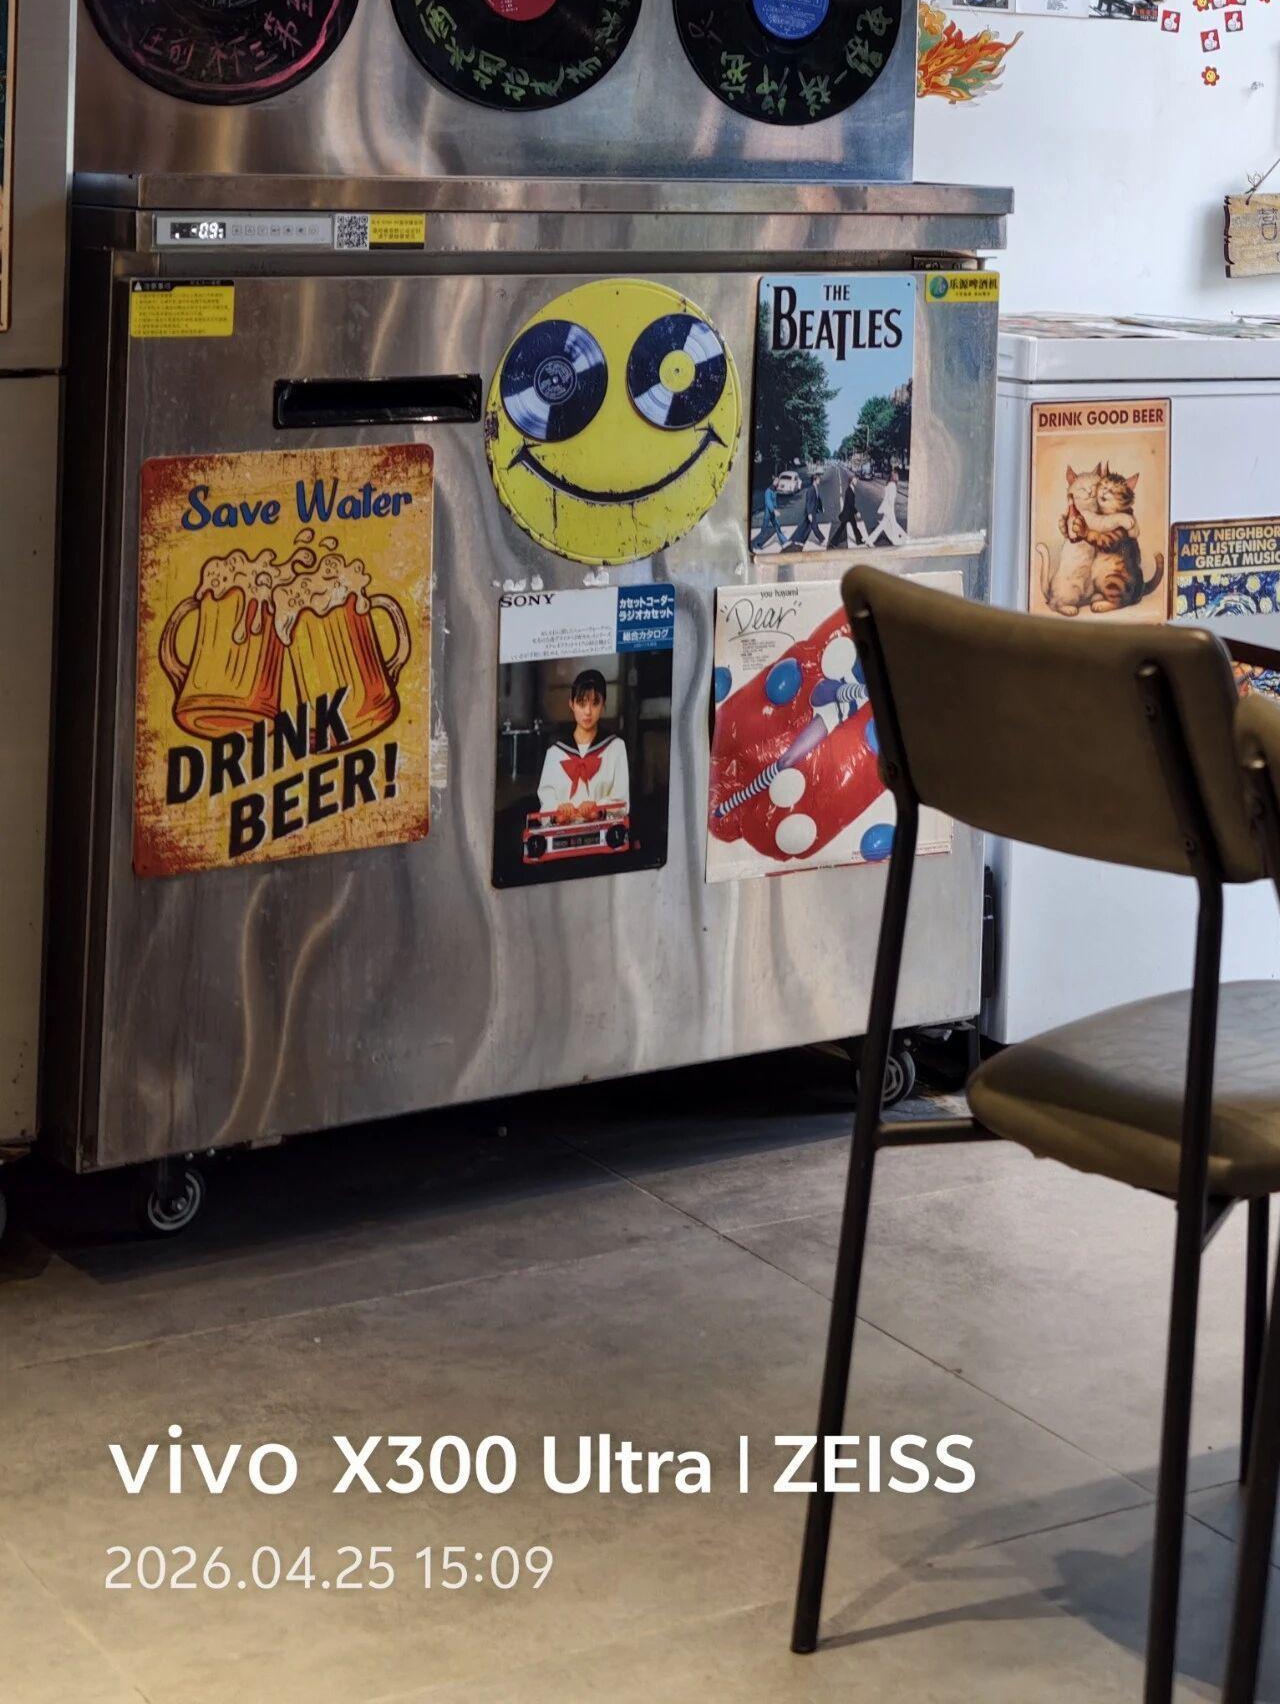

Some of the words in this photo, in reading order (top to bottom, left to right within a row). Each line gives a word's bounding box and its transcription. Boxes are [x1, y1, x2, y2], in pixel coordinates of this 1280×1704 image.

[823, 284, 850, 302] THE
[771, 285, 903, 361] BEATLES
[1038, 410, 1082, 428] DRINK
[1086, 409, 1129, 426] GOOD
[1132, 407, 1165, 424] BEER
[181, 483, 281, 532] Save
[295, 478, 414, 523] Water
[1190, 529, 1211, 543] MY
[1181, 543, 1207, 557] ARE
[1209, 539, 1278, 554] LISTENING
[1195, 555, 1240, 569] GREAT
[499, 593, 556, 609] SONY
[760, 591, 773, 601] you
[619, 607, 674, 622] ラジオカセット
[165, 686, 352, 807] DRINK
[227, 742, 399, 858] BEER!
